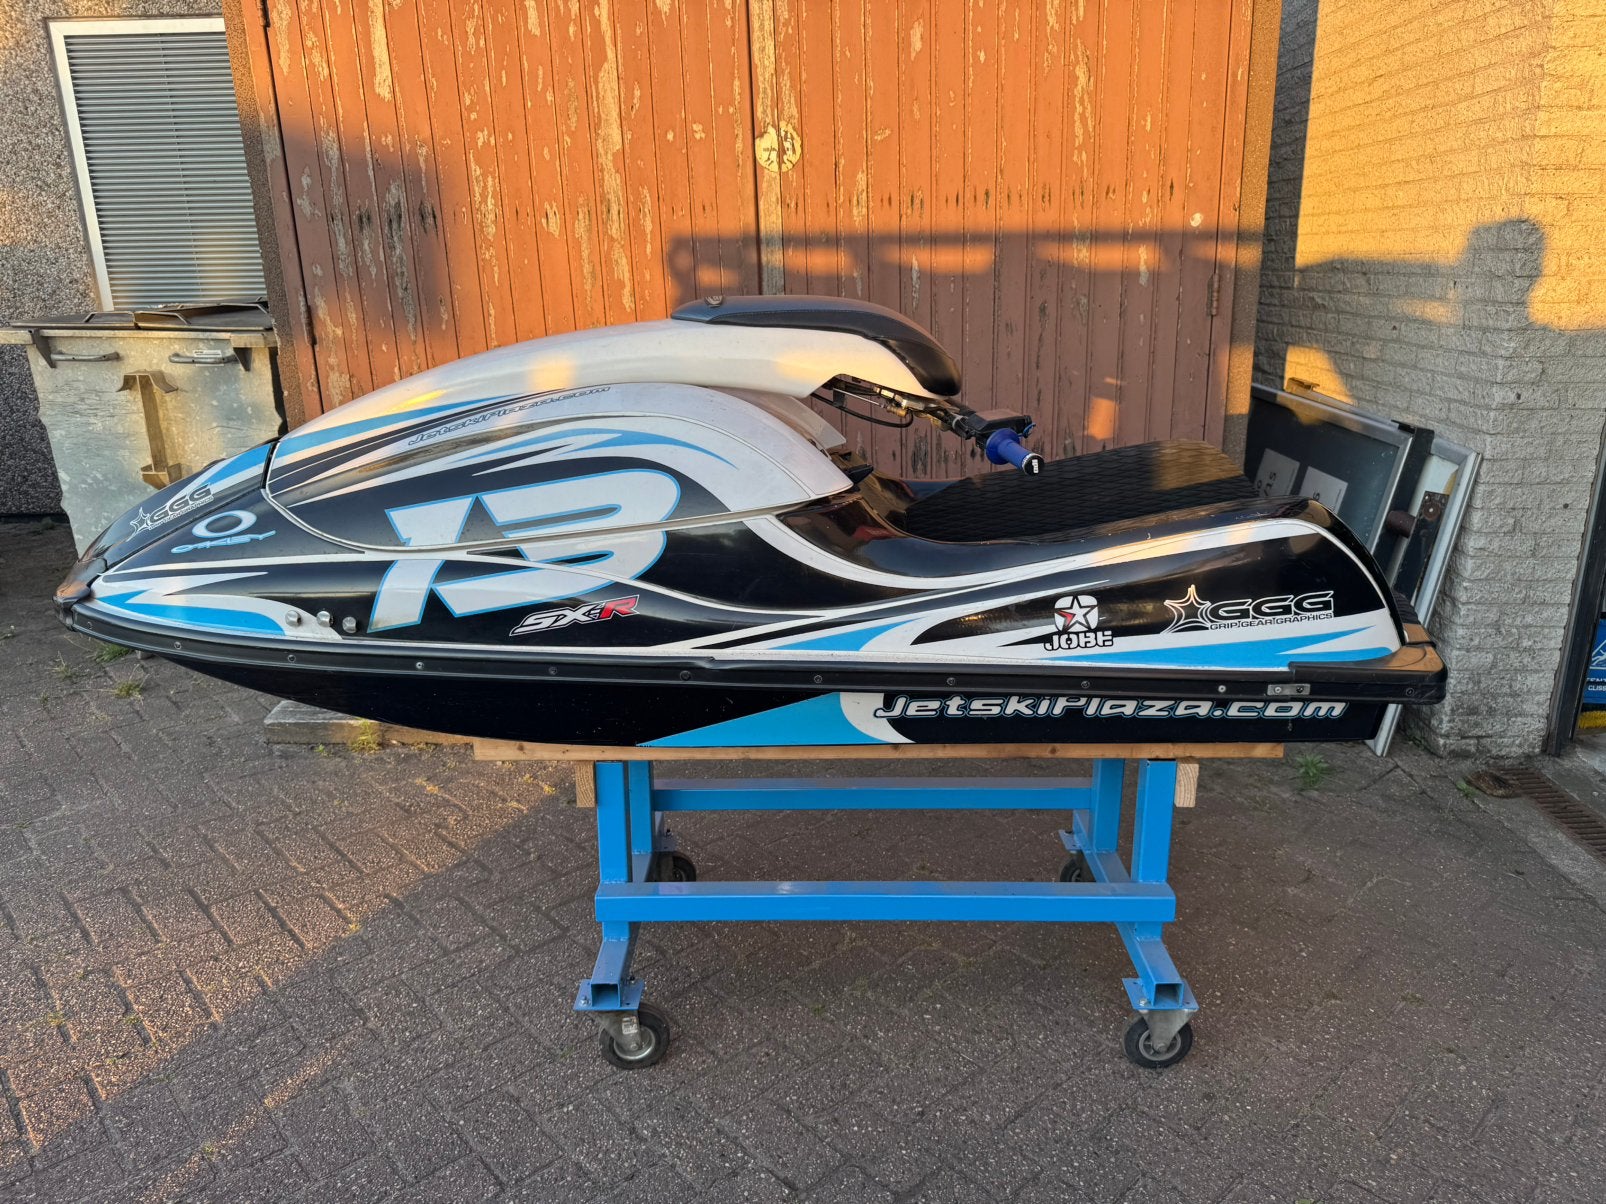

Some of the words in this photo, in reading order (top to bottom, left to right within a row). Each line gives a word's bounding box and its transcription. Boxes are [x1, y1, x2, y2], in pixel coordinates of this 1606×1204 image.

[148, 483, 213, 525] GGG
[367, 468, 681, 633] 13
[1208, 591, 1335, 621] GGG
[1044, 630, 1114, 651] JOBE
